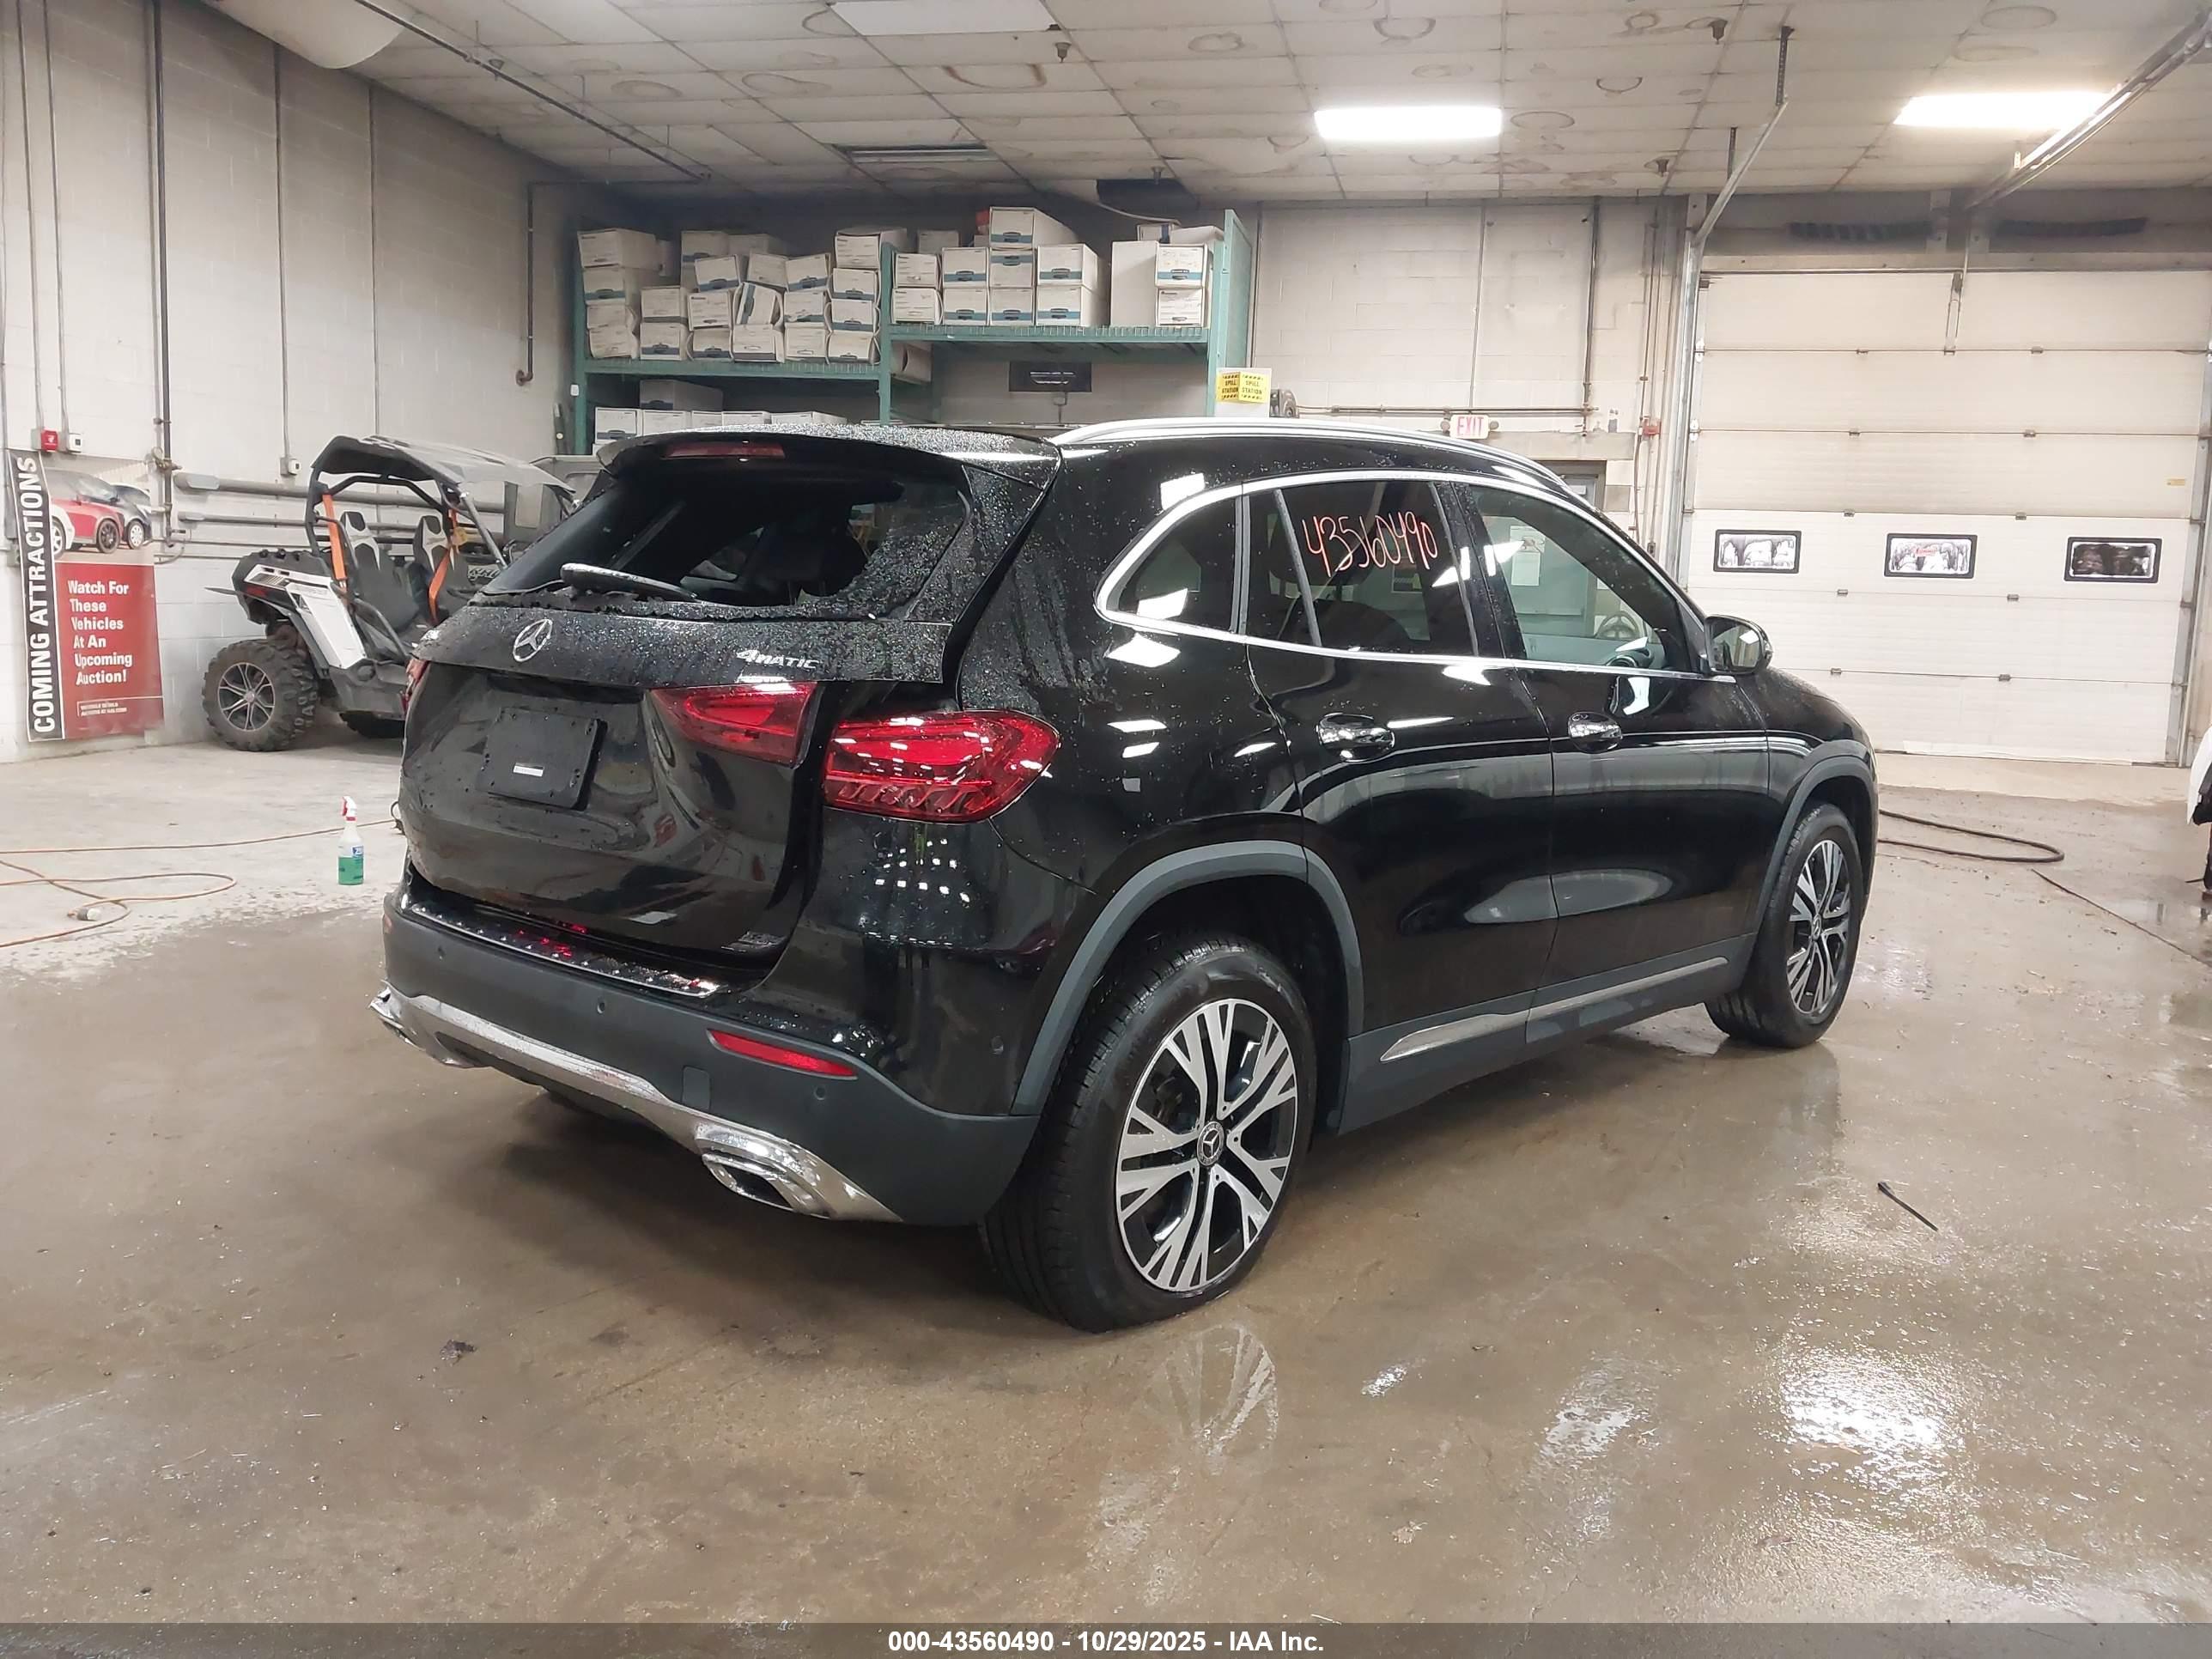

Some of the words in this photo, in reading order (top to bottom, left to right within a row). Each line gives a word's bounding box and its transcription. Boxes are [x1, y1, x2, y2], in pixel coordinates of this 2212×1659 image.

[1242, 386, 1262, 395] STATION
[1457, 416, 1484, 436] EXIT
[17, 457, 49, 627] ATTRACTIONS
[1302, 511, 1437, 577] 43560490
[68, 580, 106, 594] Watch
[109, 580, 130, 594] For
[70, 598, 107, 612] These
[71, 617, 124, 630] Vehicles
[73, 635, 85, 648] At
[87, 635, 106, 648] An
[74, 652, 133, 669] Upcoming
[29, 633, 56, 732] COMING
[76, 669, 127, 685] Auction!
